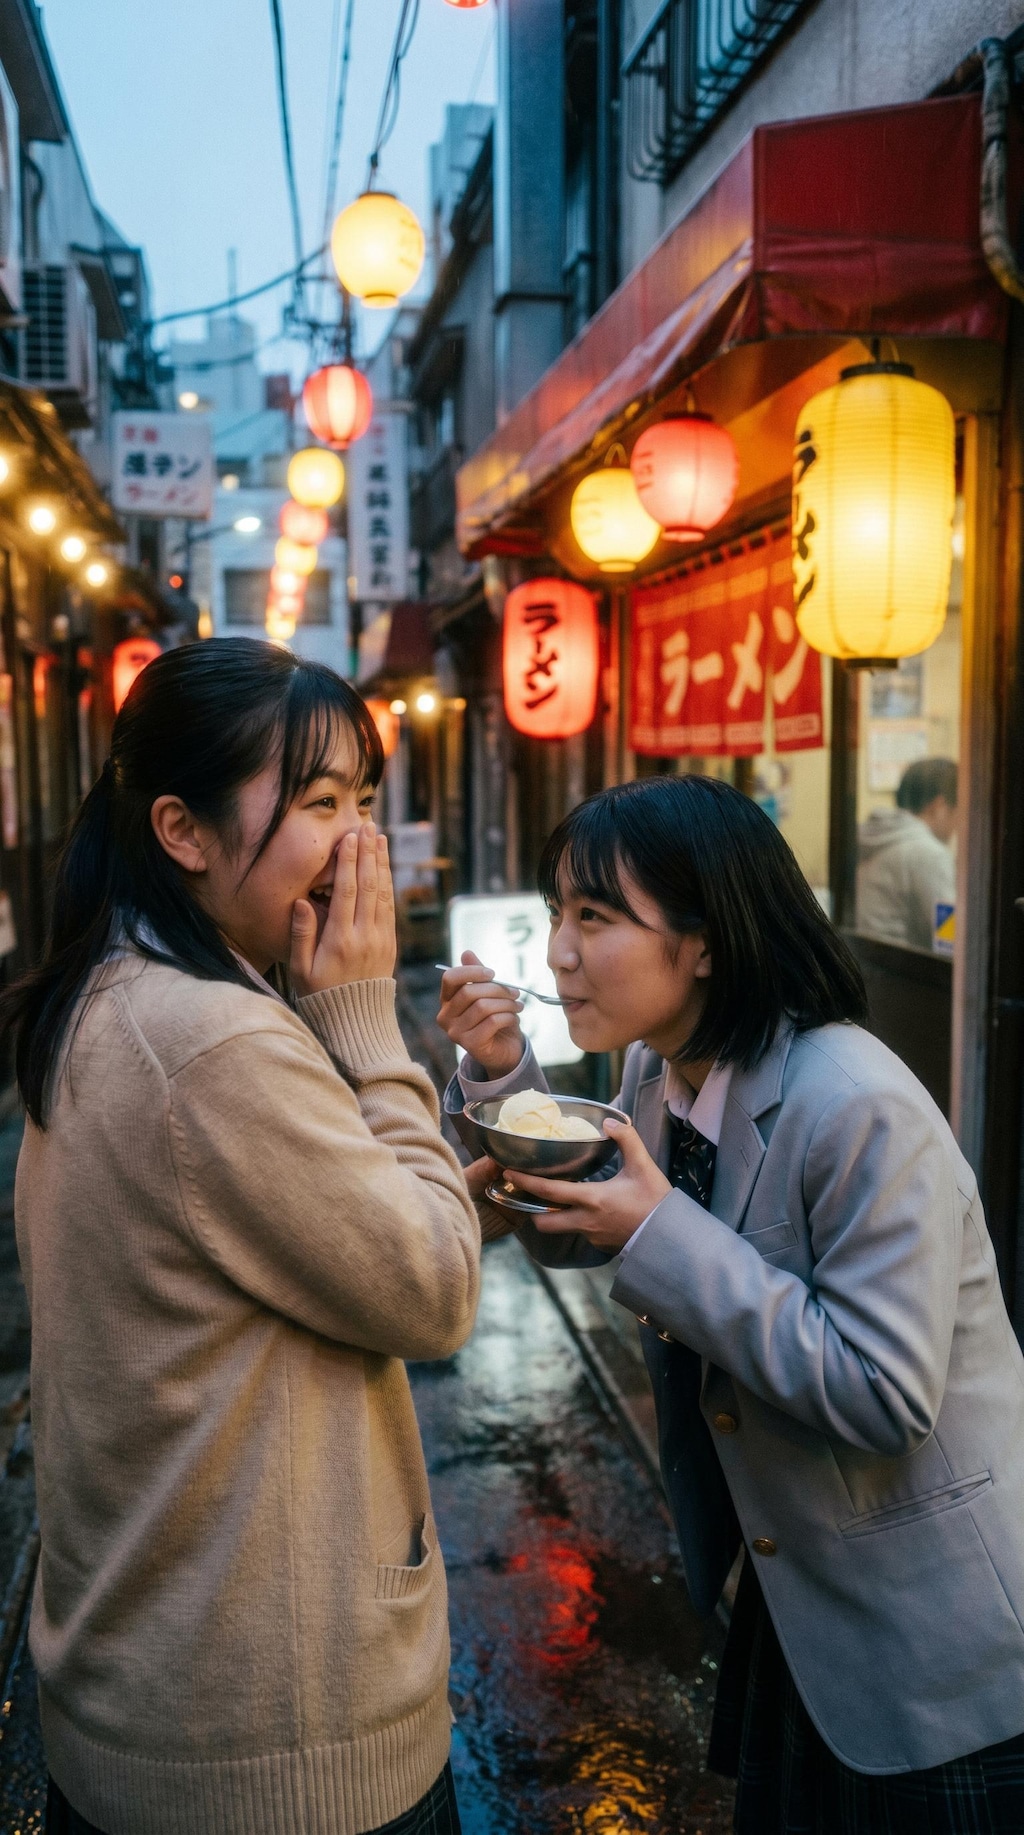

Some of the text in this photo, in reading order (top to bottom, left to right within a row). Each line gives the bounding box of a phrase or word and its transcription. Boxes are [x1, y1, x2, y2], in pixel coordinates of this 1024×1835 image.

[523, 603, 559, 709] ラーメン
[660, 610, 809, 717] ラーメン
